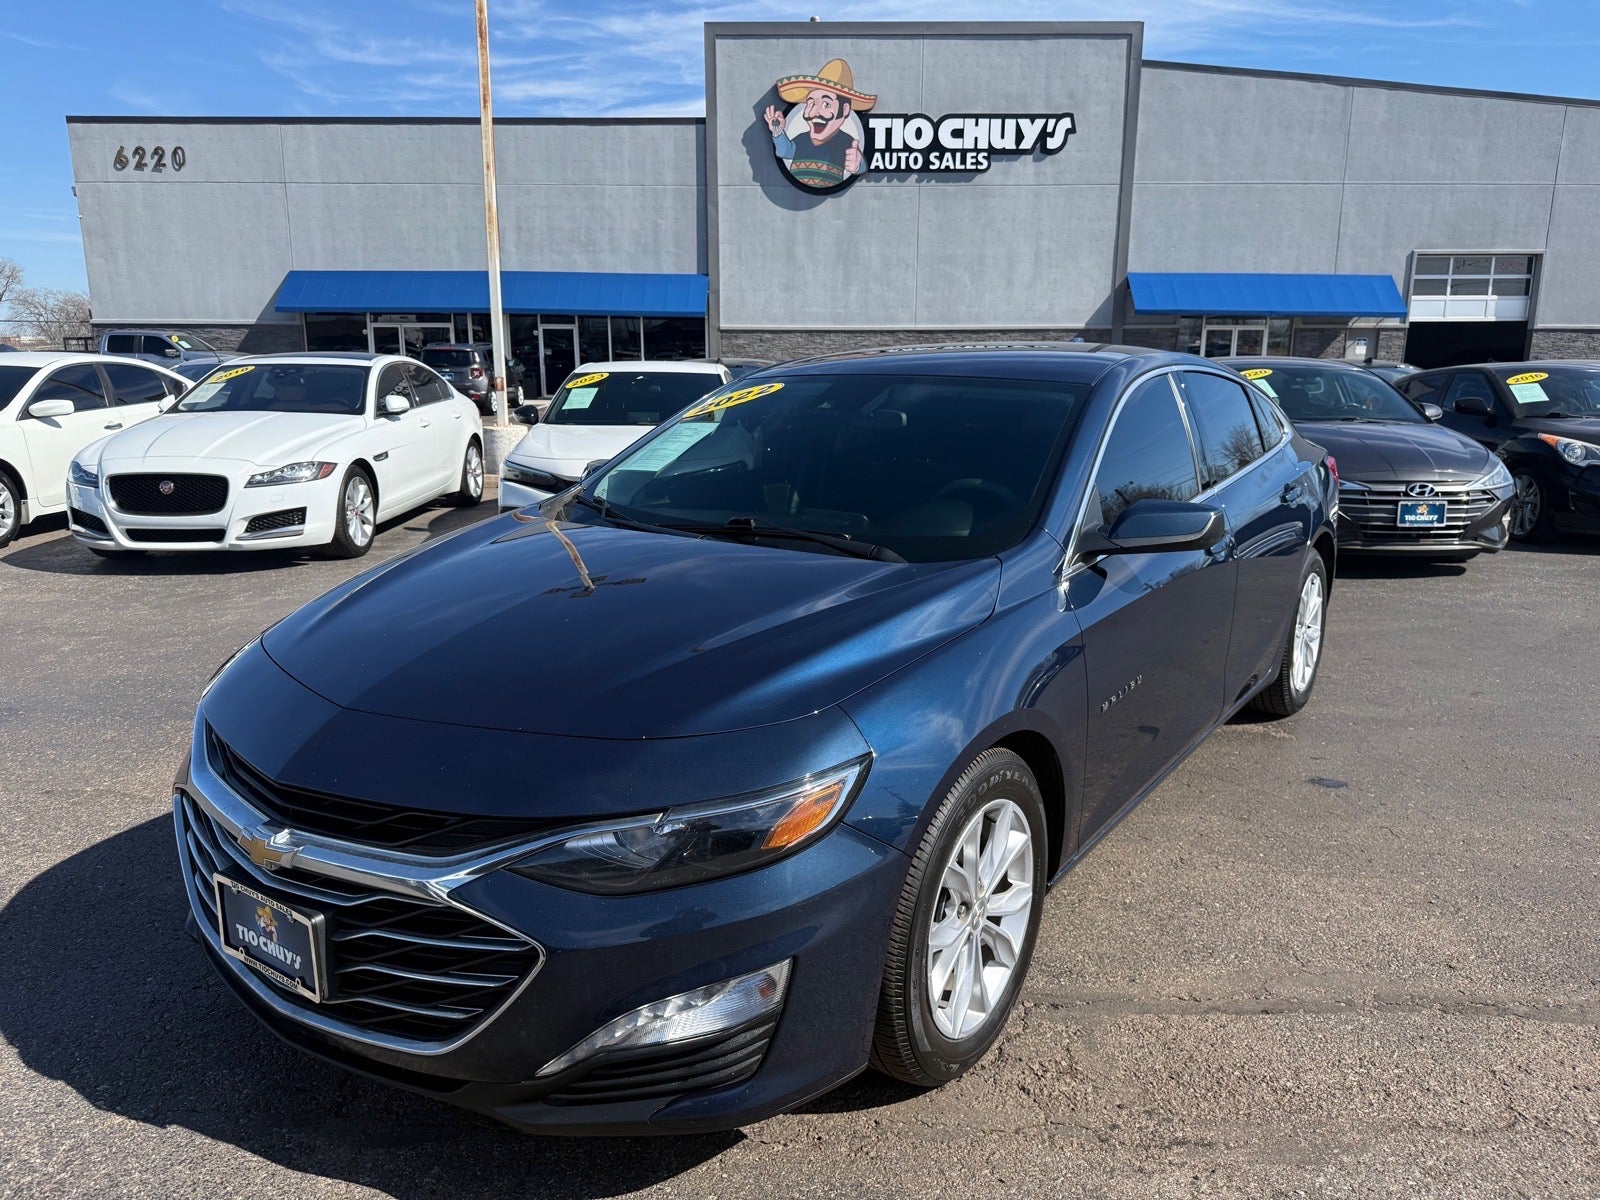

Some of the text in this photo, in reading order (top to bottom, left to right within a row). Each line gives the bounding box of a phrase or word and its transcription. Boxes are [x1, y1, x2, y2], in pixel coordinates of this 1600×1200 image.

[869, 116, 1073, 150] TIO CHUY'S
[114, 146, 186, 172] 6220
[869, 152, 989, 170] AUTO SALES
[691, 384, 775, 415] 2022
[235, 922, 302, 970] TIO CHUY'S
